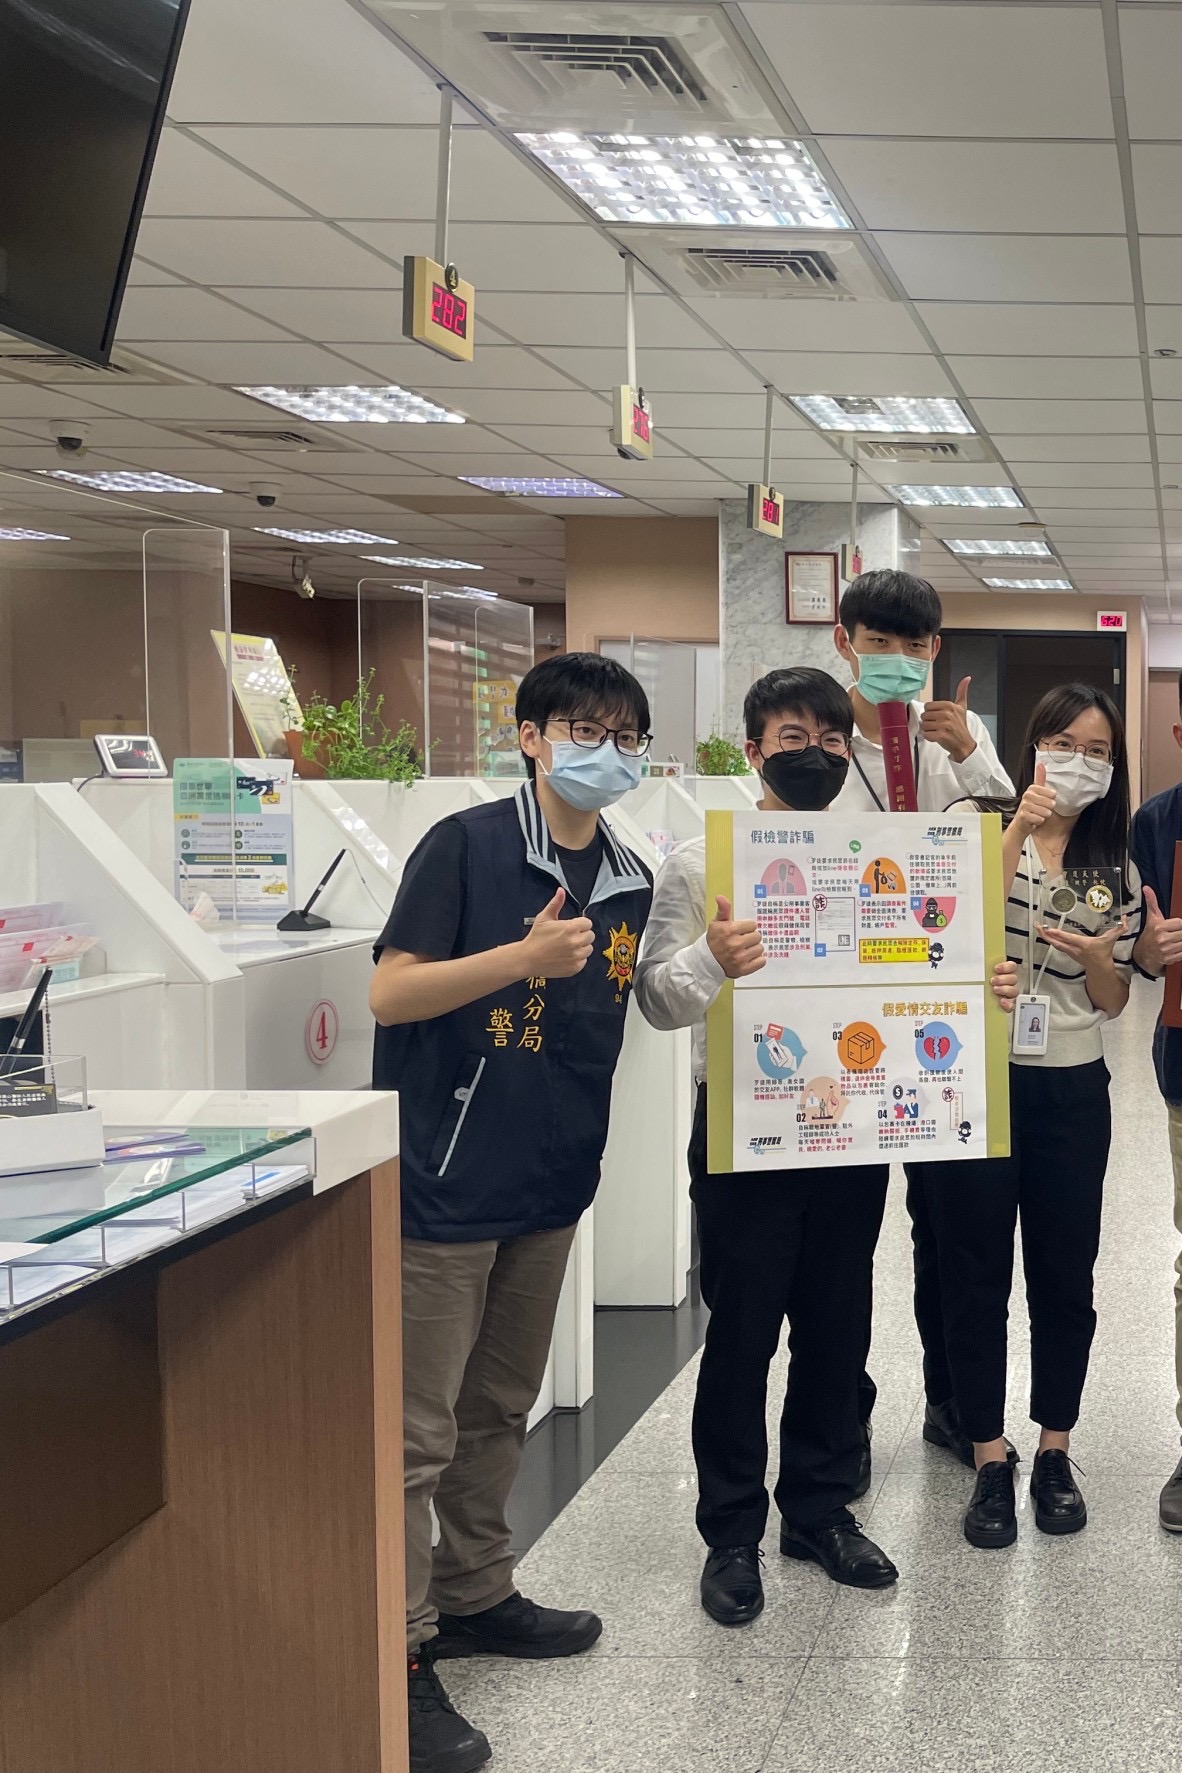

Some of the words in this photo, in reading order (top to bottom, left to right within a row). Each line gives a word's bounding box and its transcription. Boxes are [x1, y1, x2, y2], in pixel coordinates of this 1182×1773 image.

[431, 286, 466, 335] 282
[1101, 615, 1122, 626] 620
[751, 830, 815, 844] 假檢警詐騙
[881, 1001, 968, 1017] 假愛情交友詐騙
[315, 1010, 328, 1049] 4
[485, 1007, 515, 1048] 警
[753, 1033, 763, 1043] 01
[832, 1031, 843, 1040] 03
[914, 1028, 925, 1039] 05
[796, 1113, 806, 1122] 02
[877, 1110, 888, 1119] 04
